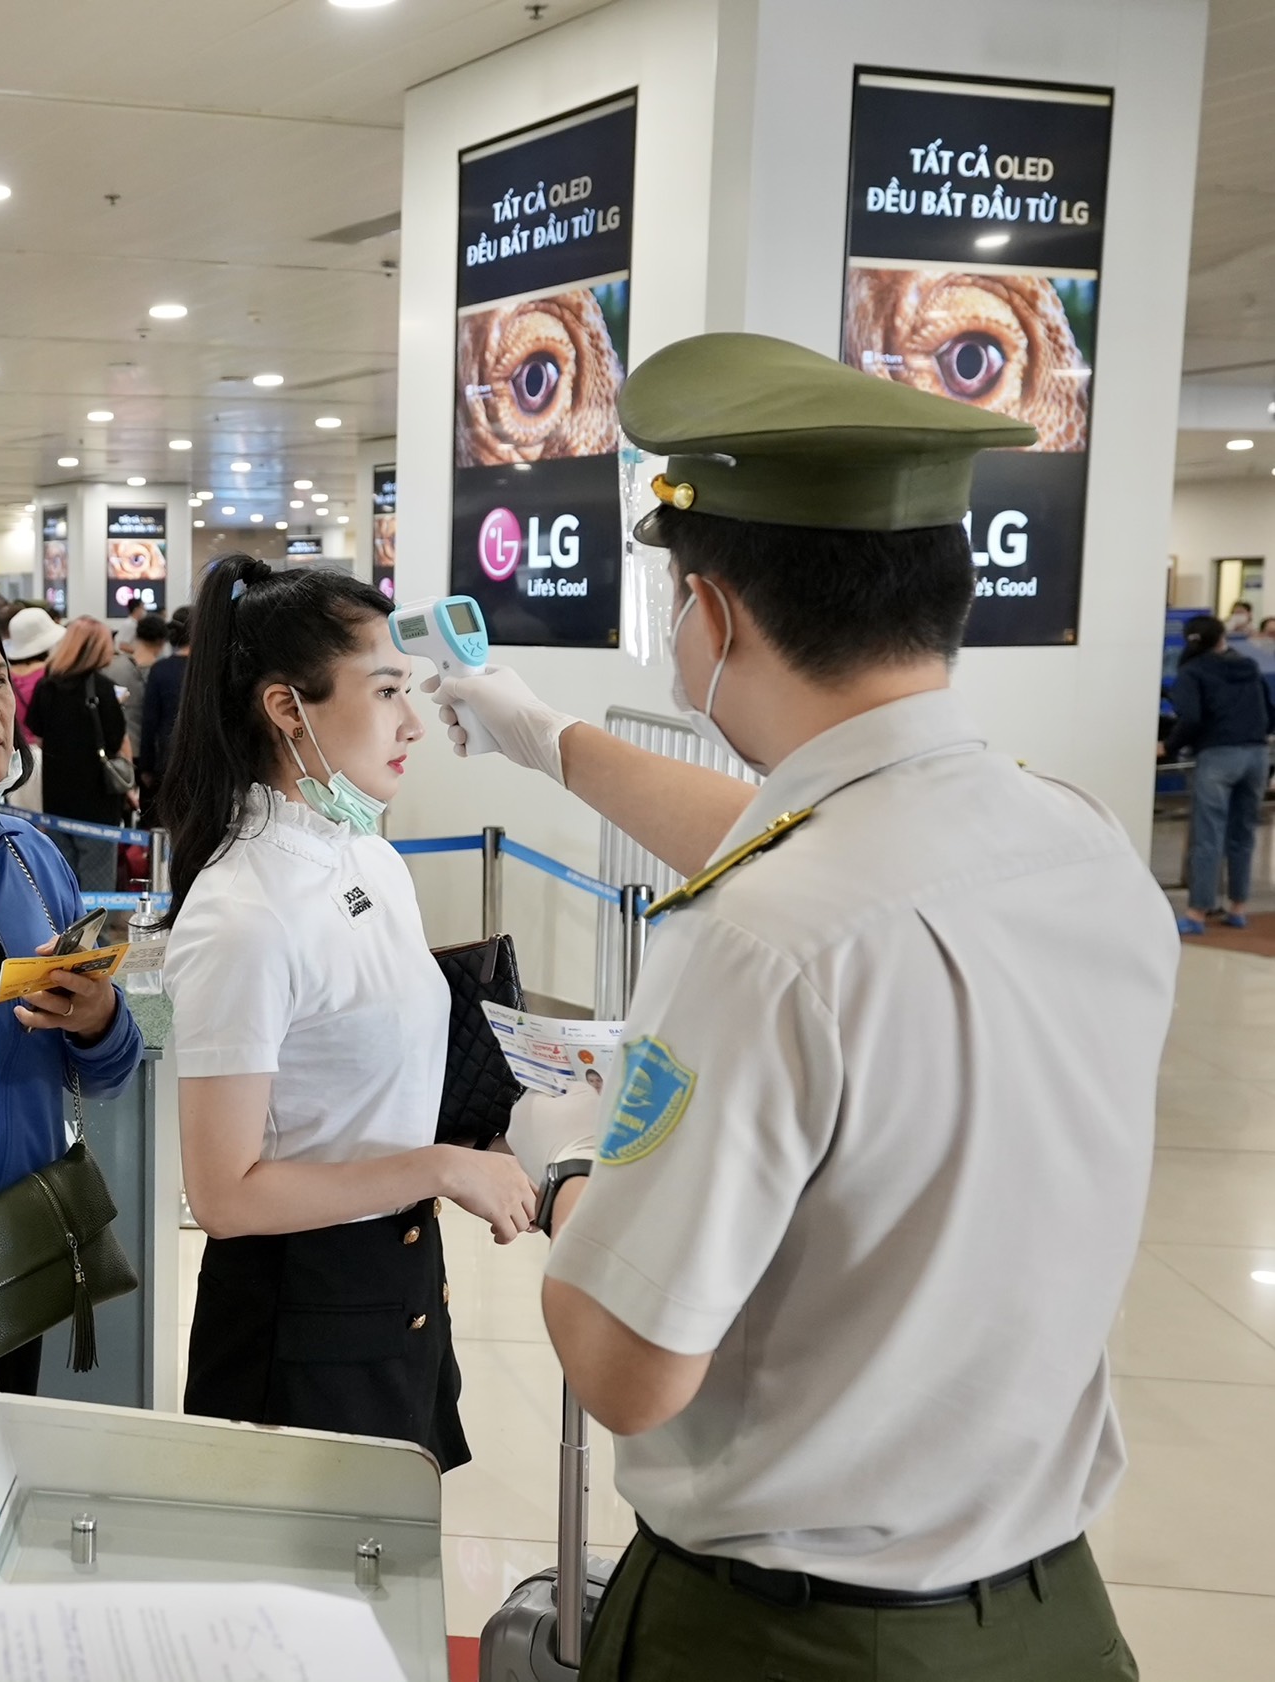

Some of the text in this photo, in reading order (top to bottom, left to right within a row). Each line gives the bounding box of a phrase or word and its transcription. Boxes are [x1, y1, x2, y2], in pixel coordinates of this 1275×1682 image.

[909, 138, 1054, 182] TẤT CẢ OLED
[492, 175, 592, 224] TẤT CẢ OLED
[866, 176, 1089, 225] ĐỀU BẮT ĐẦU TỪ LG
[466, 205, 621, 267] ĐỀU BẮT ĐẦU TỪ LG
[528, 513, 580, 568] LG
[962, 510, 1028, 567] LG
[527, 577, 588, 597] Life's Good
[975, 577, 1038, 597] e's Good
